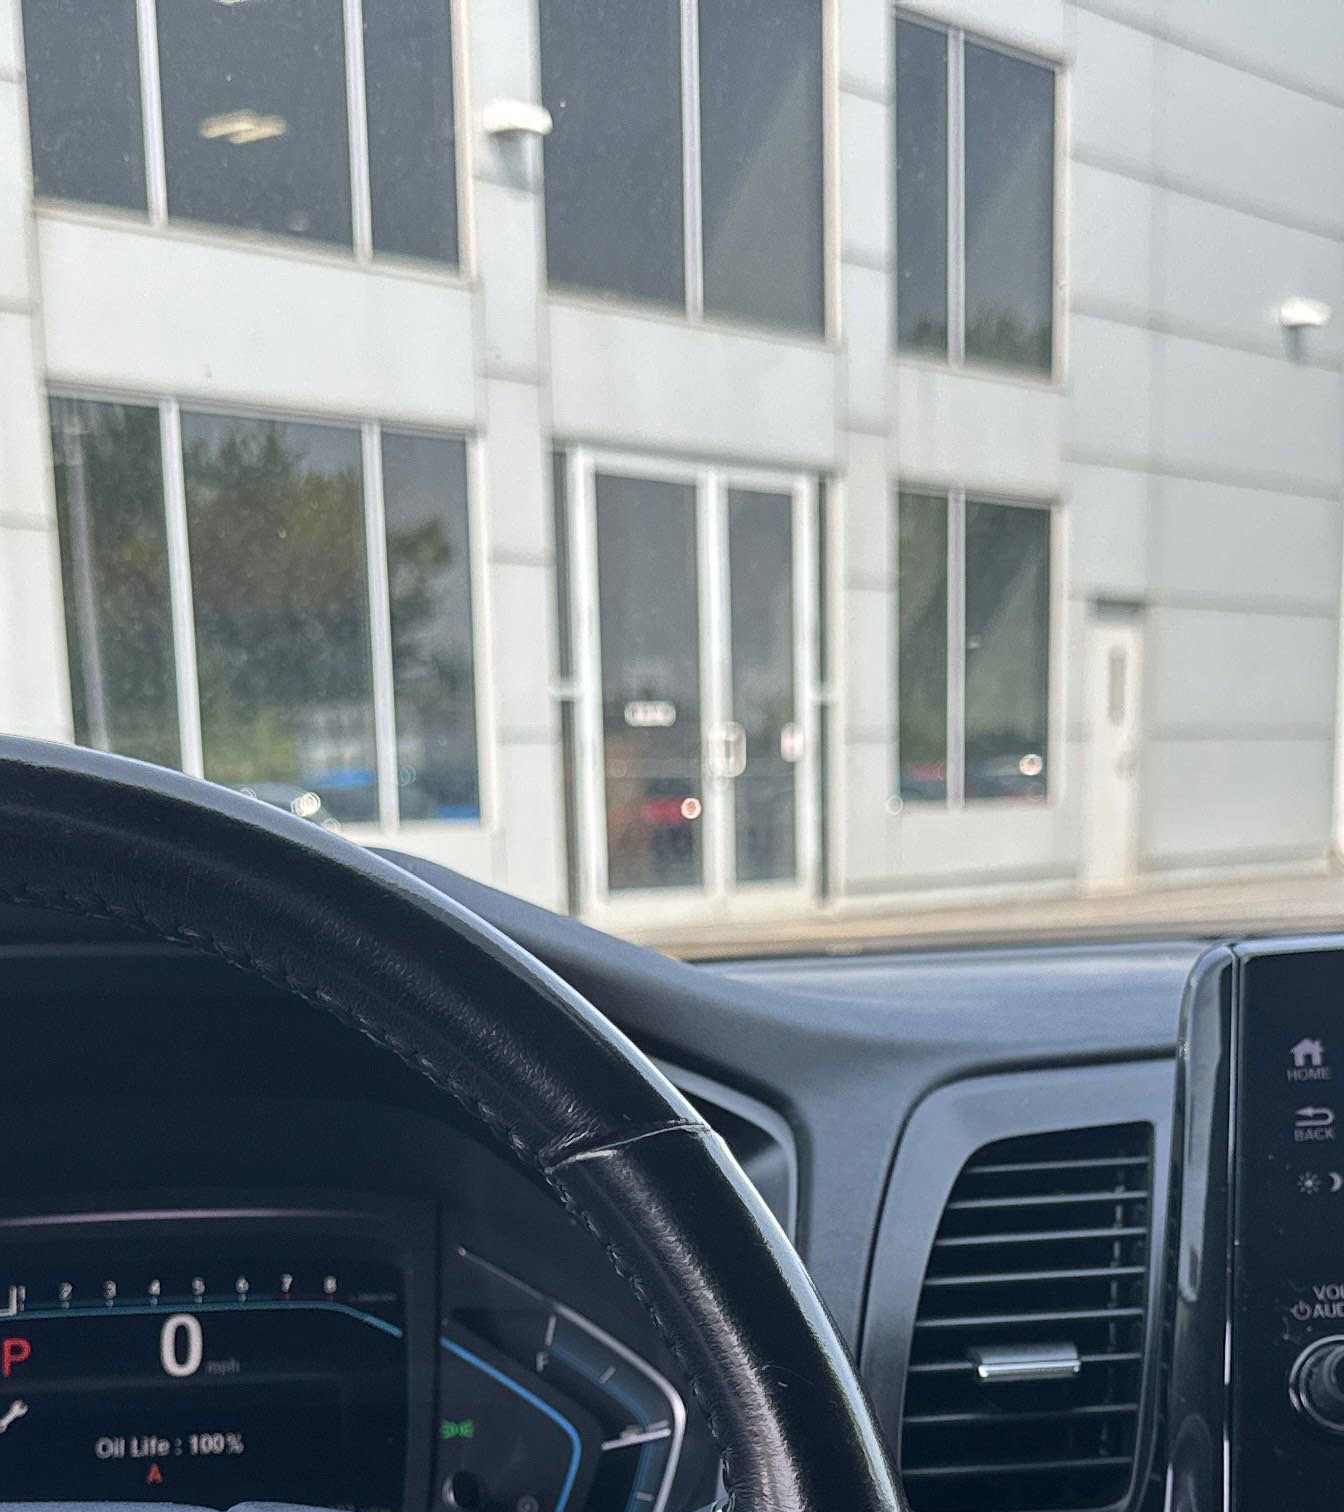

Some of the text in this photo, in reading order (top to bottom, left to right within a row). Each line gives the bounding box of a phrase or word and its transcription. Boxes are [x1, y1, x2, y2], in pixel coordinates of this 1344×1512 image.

[1287, 1068, 1331, 1081] HOME
[1294, 1128, 1336, 1142] BACK
[1, 1337, 32, 1378] P
[160, 1313, 203, 1378] 0
[95, 1436, 126, 1459] Oil
[130, 1436, 169, 1458] Life
[188, 1433, 245, 1456] 100%
